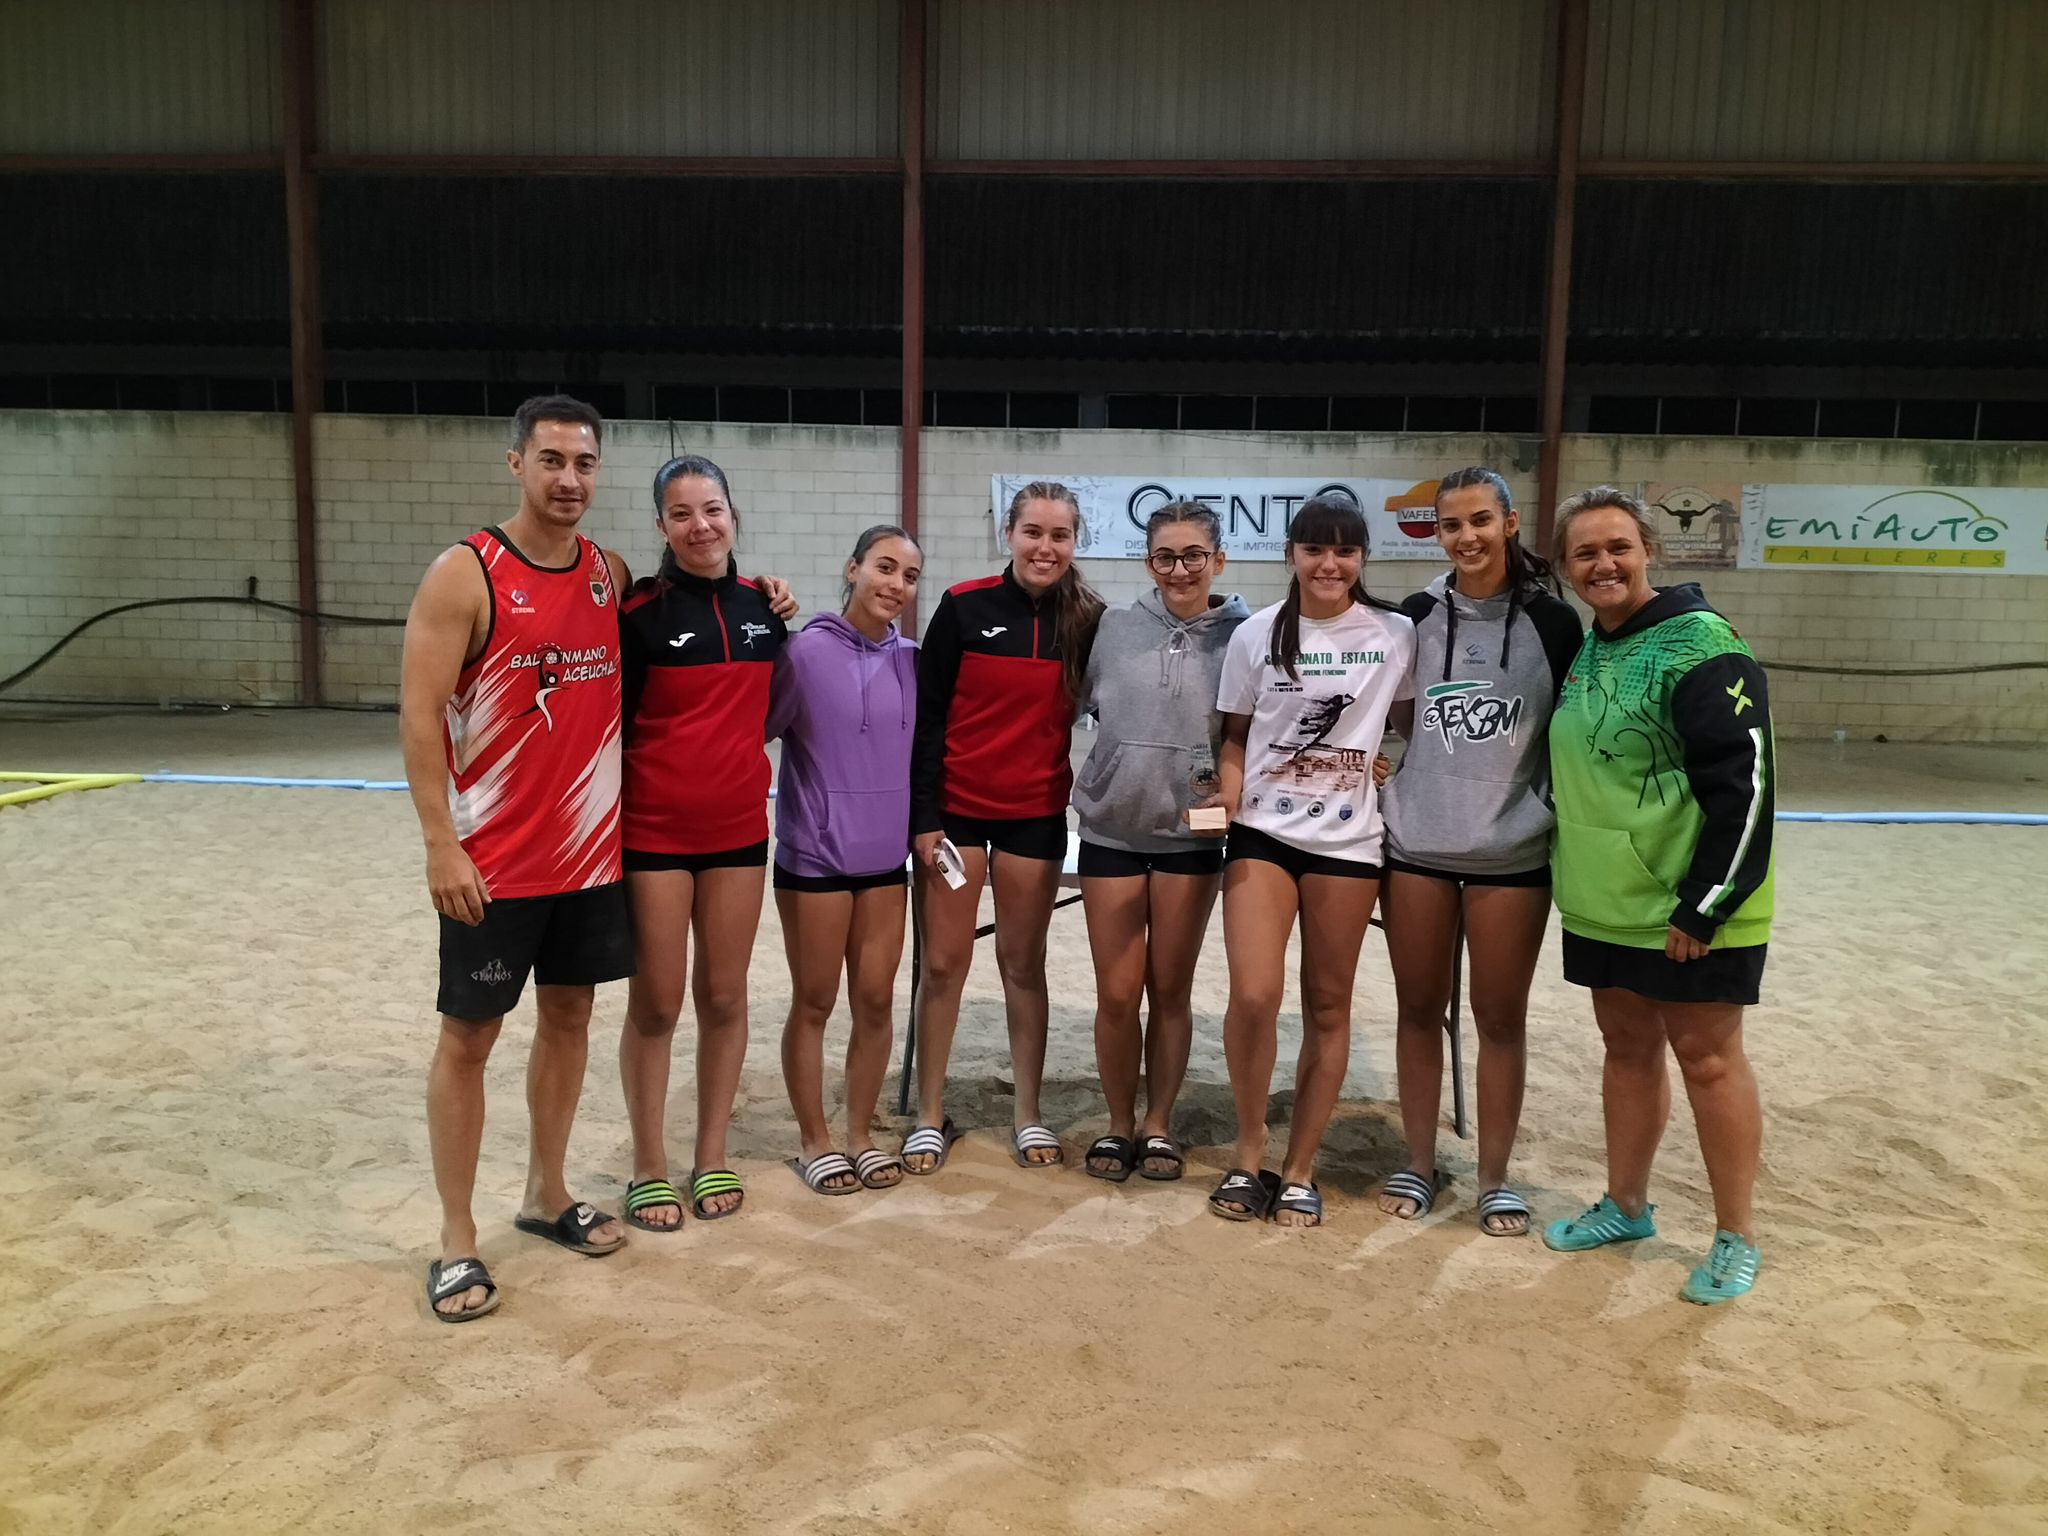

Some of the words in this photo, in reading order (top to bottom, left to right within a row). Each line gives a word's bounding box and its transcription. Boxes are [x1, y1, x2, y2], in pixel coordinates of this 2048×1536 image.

[1127, 483, 1363, 537] CNT
[1768, 548, 2001, 565] TALLERES
[1264, 652, 1333, 665] CEONATO
[1341, 651, 1385, 664] ESTATAL
[441, 1262, 469, 1285] NIKE
